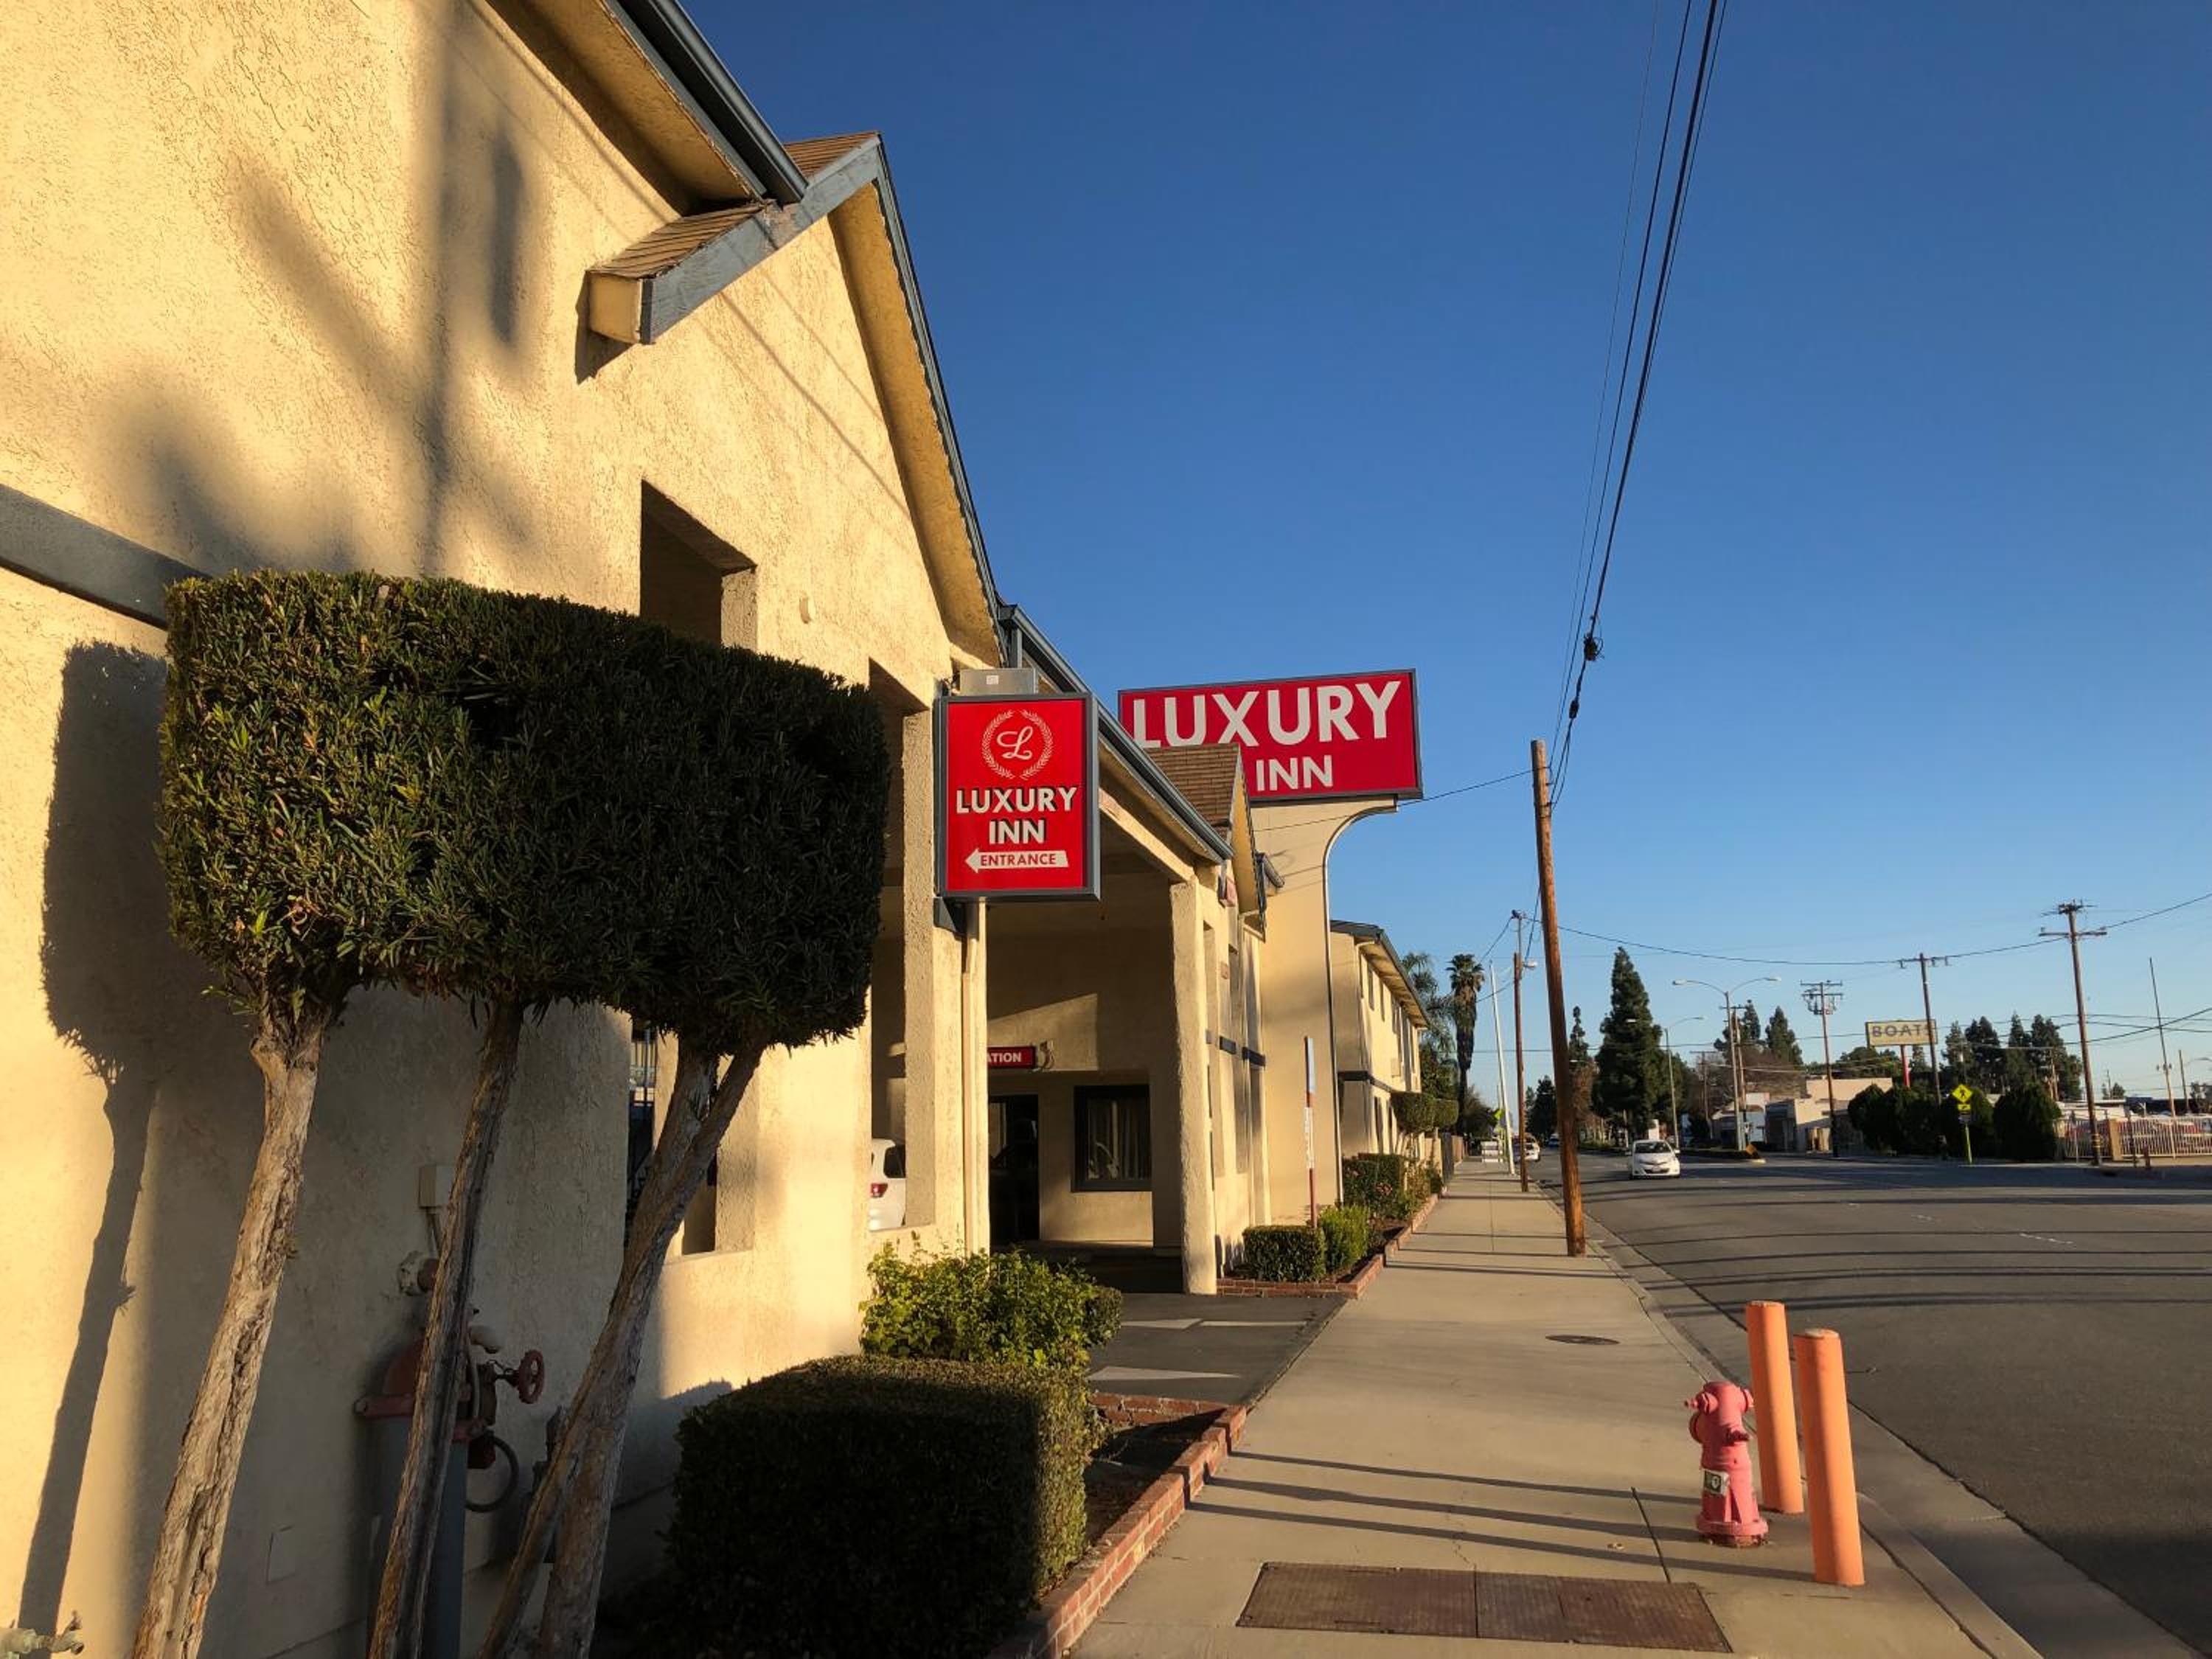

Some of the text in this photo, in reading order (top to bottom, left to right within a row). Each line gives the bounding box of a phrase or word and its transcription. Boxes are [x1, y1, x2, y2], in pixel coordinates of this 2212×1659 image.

[1133, 681, 1401, 748] LUXURY
[1256, 755, 1334, 791] INN
[956, 786, 1077, 813] LUXURY
[989, 818, 1046, 845] INN
[980, 853, 1057, 866] ENTRANCE
